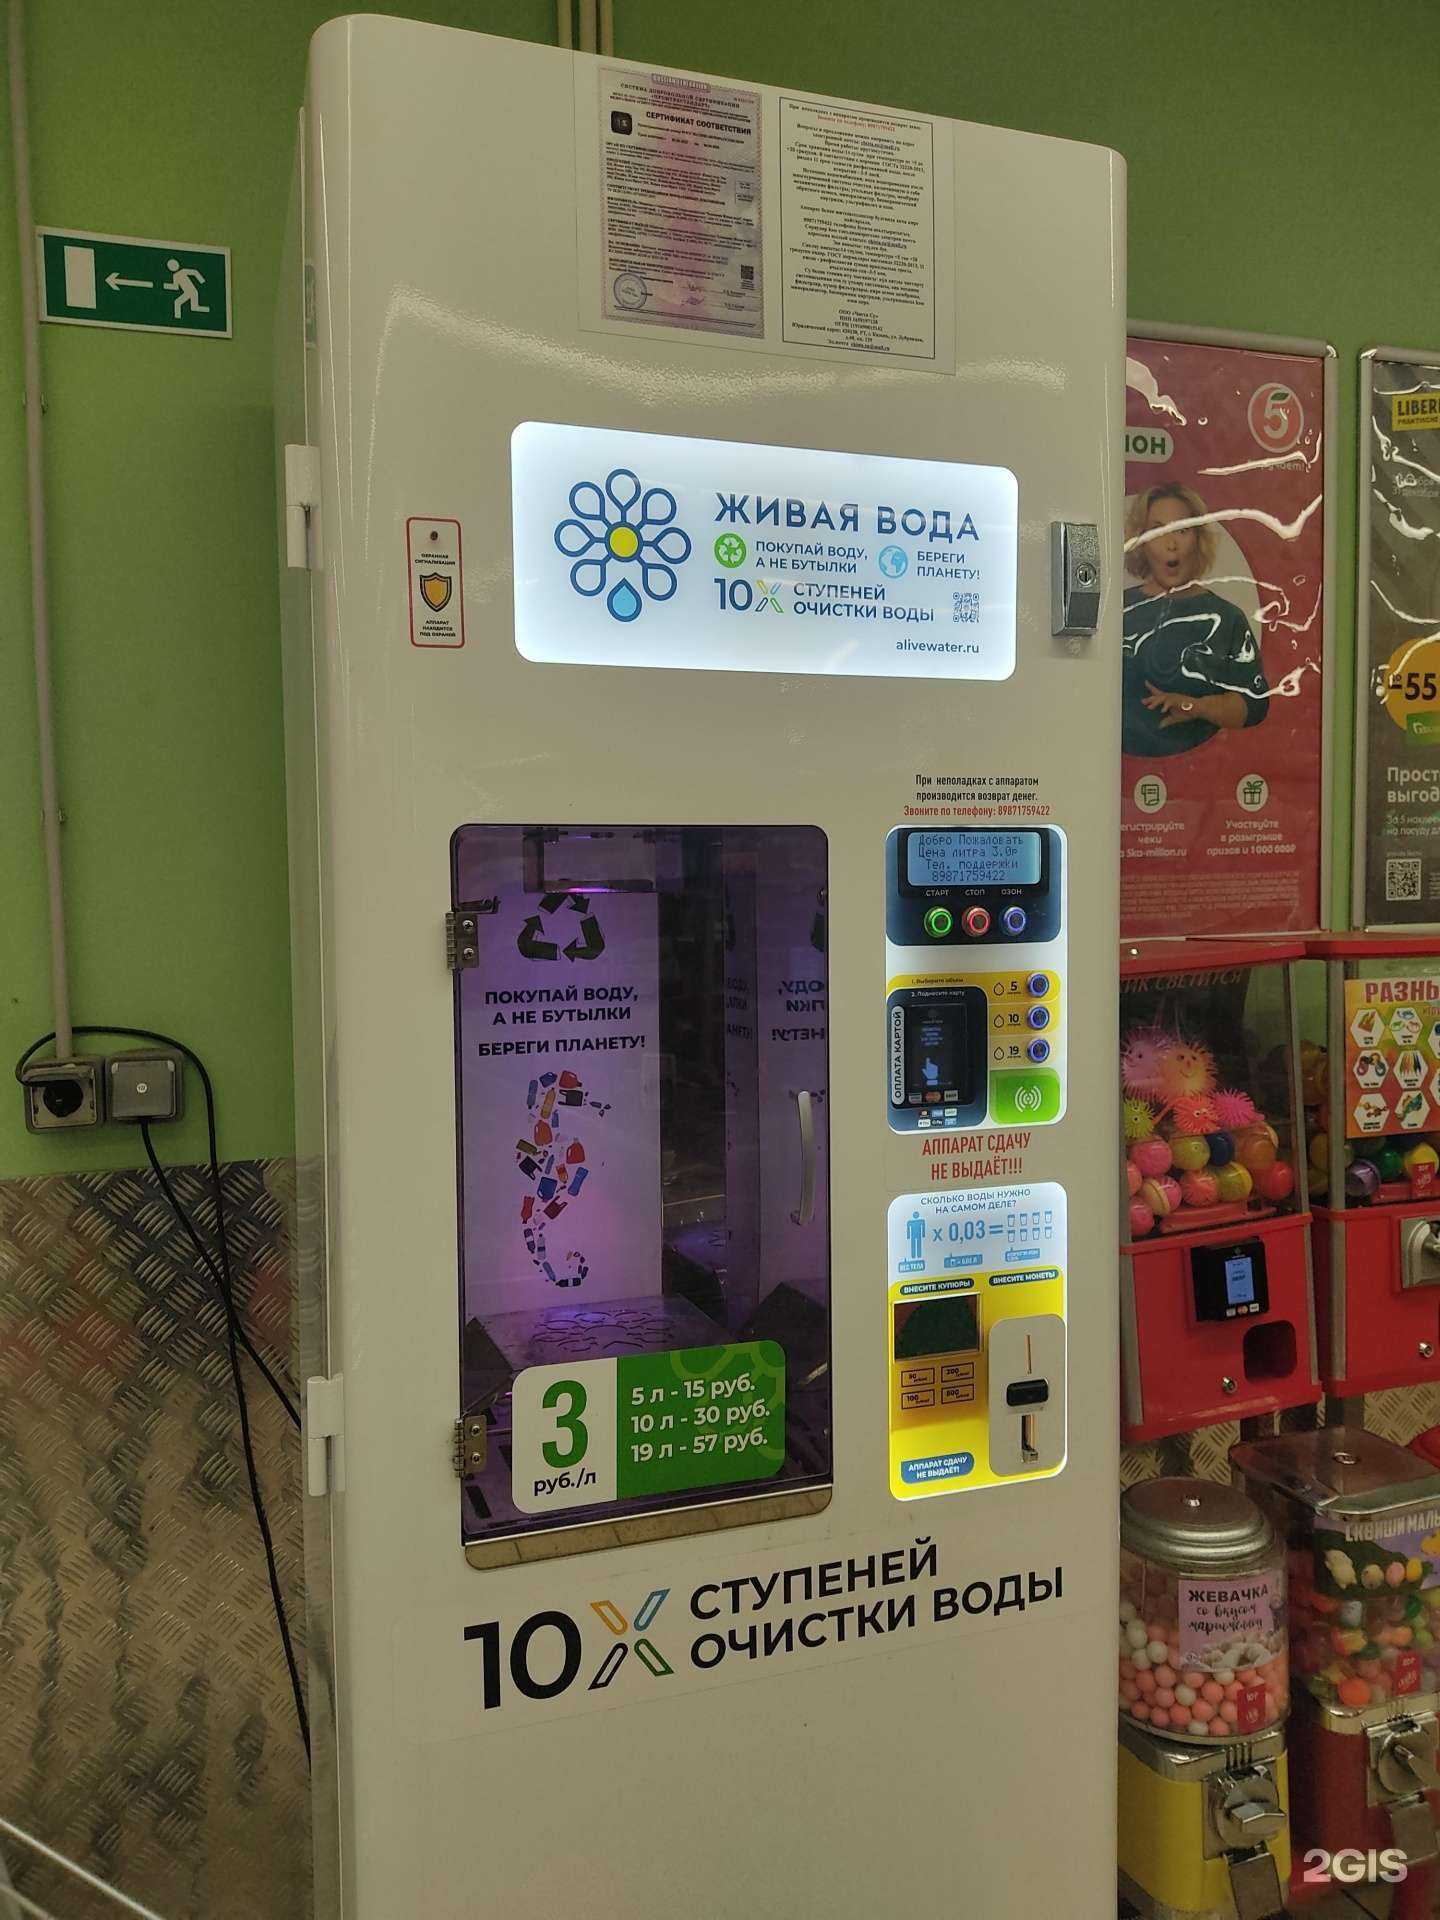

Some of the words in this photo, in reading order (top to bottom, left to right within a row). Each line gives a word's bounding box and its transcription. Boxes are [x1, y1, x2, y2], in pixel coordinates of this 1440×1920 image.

[646, 111, 694, 125] СЕРТИФИКАТ
[696, 120, 752, 135] СООТВЕТСТВИЯ
[1397, 398, 1440, 416] LIBER
[714, 492, 859, 532] ЖИВАЯ
[876, 505, 980, 544] ВОДА
[756, 540, 823, 557] ПОКУПАЙ
[827, 546, 868, 560] ВОДУ,
[917, 551, 966, 564] БЕРЕГИ
[756, 558, 766, 568] А
[770, 558, 788, 570] НЕ
[792, 559, 857, 574] БУТЫЛКИ
[917, 566, 980, 580] ПЛАНЕТУ!
[793, 580, 886, 601] СТУПЕНЕЙ
[793, 601, 877, 619] ОЧИСТКИ
[883, 606, 934, 622] ВОДЫ
[896, 639, 980, 654] alivewater.ru
[915, 774, 932, 787] При
[936, 776, 987, 786] неполадках
[988, 777, 994, 786] с
[995, 776, 1039, 786] аппаратом
[916, 792, 976, 802] производится
[978, 792, 1010, 802] возврат
[1012, 792, 1038, 802] денег.
[903, 805, 939, 816] Звоните
[940, 807, 951, 816] по
[953, 806, 996, 818] телефону:
[998, 805, 1051, 816] 89871759422
[1120, 820, 1184, 832] егистрируйте
[918, 834, 952, 846] Добро
[958, 834, 1024, 846] Пожаловать
[918, 845, 946, 859] Цена
[952, 847, 986, 857] литра
[926, 859, 950, 870] Тел.
[959, 860, 1018, 870] поддержки
[932, 870, 1006, 882] 89871759422
[1001, 888, 1022, 896] ОЗОН
[485, 986, 578, 1005] ПОКУПАЙ
[584, 986, 639, 1002] ВОДУ,
[1010, 982, 1018, 991] 5
[492, 1011, 508, 1026] А
[512, 1010, 536, 1025] НЕ
[542, 1007, 632, 1024] БУТЫЛКИ
[1009, 1014, 1020, 1022] 10
[894, 1010, 902, 1052] КАРТОЙ
[478, 1040, 550, 1057] БЕРЕГИ
[554, 1036, 646, 1054] ПЛАНЕТУ!
[1009, 1046, 1020, 1054] 19
[894, 1054, 902, 1098] ОПЛАТА
[922, 1136, 984, 1156] АППАРАТ
[988, 1132, 1031, 1153] СДАЧУ
[931, 1163, 948, 1180] НЕ
[952, 1156, 1023, 1178] ВЫДАЁТ!!!
[920, 1194, 964, 1205] СКОЛЬКО
[967, 1192, 995, 1201] ВОДЫ
[997, 1188, 1031, 1198] НУЖНО
[936, 1206, 949, 1214] НА
[951, 1203, 986, 1213] САМОМ
[988, 1200, 1017, 1210] ДЕЛЕ?
[948, 1220, 986, 1244] 0,03
[993, 1274, 1024, 1284] ВНЕСИТЕ
[1025, 1271, 1056, 1281] МОНЕТЫ
[904, 1284, 936, 1294] ВНЕСИТЕ
[938, 1281, 970, 1290] КУПЮРЫ
[631, 1386, 644, 1406] 5
[650, 1388, 664, 1403] л
[684, 1380, 704, 1399] 15
[710, 1372, 756, 1398] руб.
[542, 1379, 589, 1469] 3
[631, 1415, 654, 1434] 10
[660, 1414, 674, 1430] л
[694, 1406, 720, 1425] 30
[726, 1398, 770, 1425] руб.
[631, 1444, 653, 1462] 19
[658, 1442, 673, 1459] л
[692, 1434, 718, 1454] 57
[724, 1426, 768, 1454] руб.
[908, 1460, 942, 1472] АППАРАТ
[944, 1456, 968, 1466] СДАЧУ
[534, 1468, 597, 1497] руб./л
[690, 1536, 940, 1622] СТУПЕНЕЙ
[1188, 1583, 1268, 1603] ЖЕВАЧКА
[690, 1594, 916, 1669] ОЧИСТКИ
[933, 1566, 1064, 1624] ВОДЫ
[1196, 1606, 1209, 1616] со
[1214, 1602, 1256, 1620] вкусом
